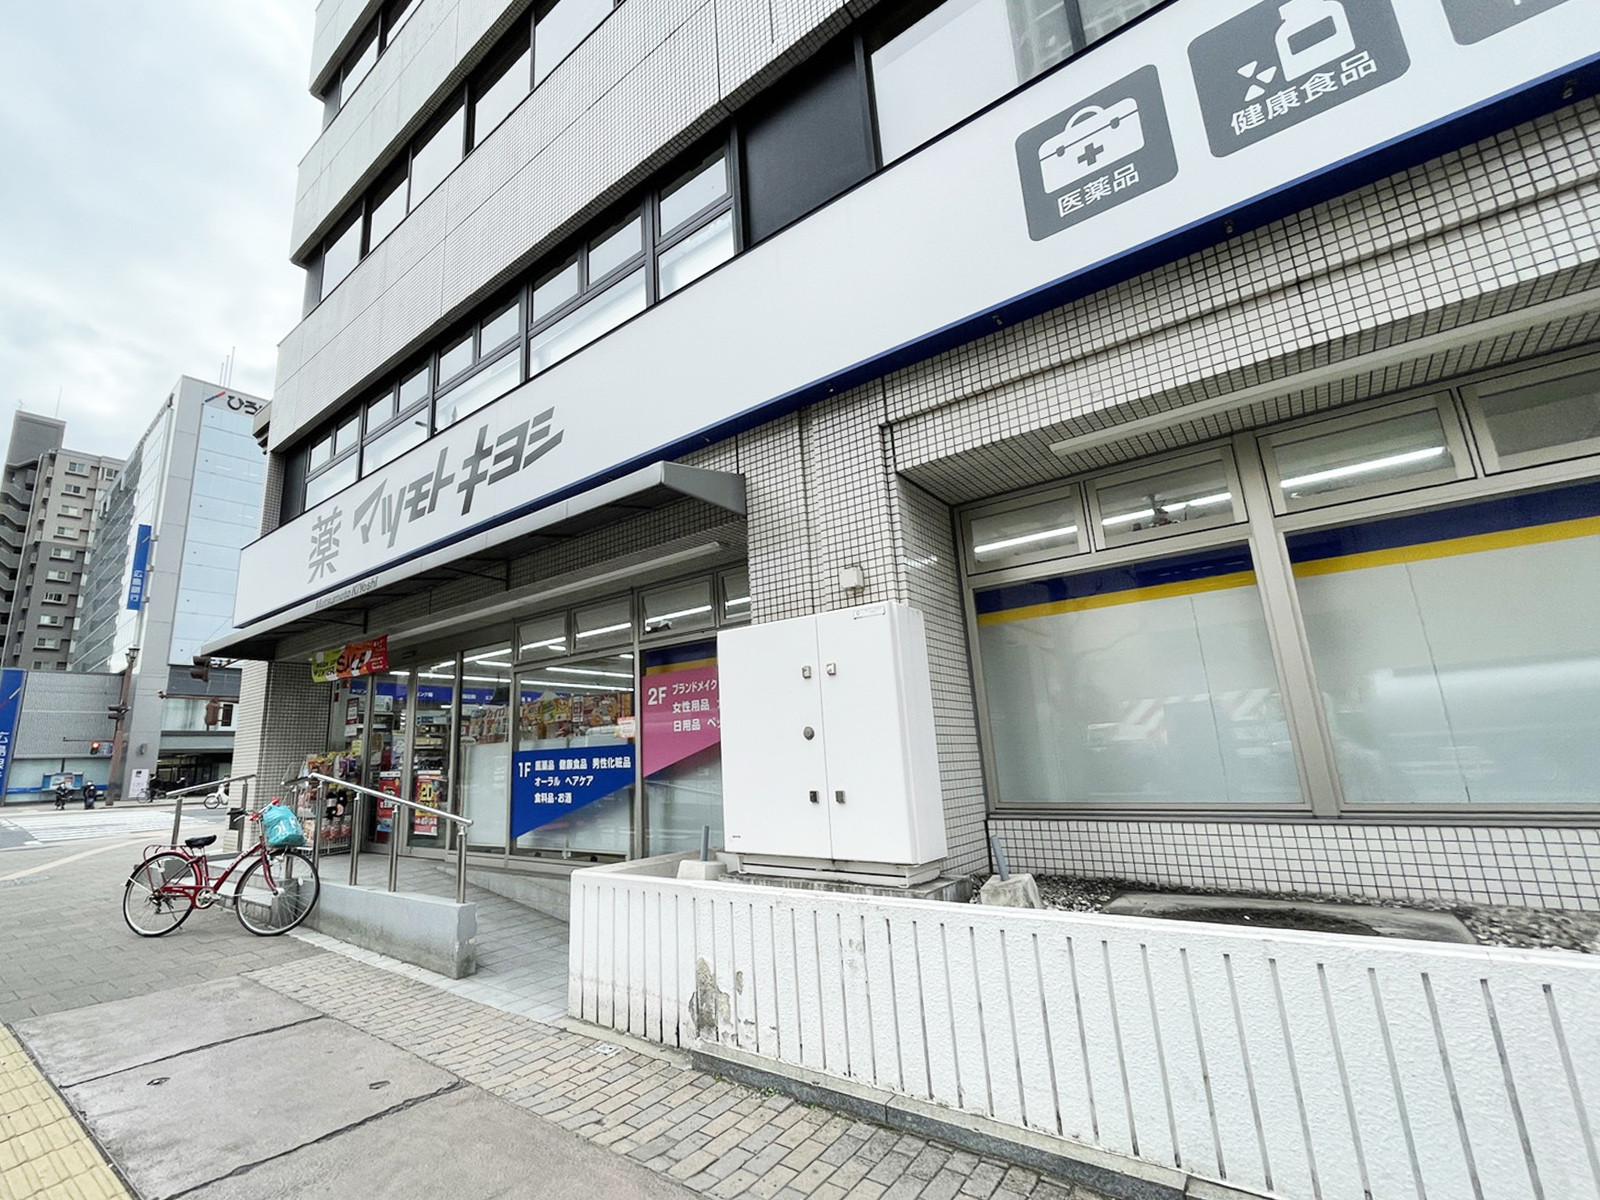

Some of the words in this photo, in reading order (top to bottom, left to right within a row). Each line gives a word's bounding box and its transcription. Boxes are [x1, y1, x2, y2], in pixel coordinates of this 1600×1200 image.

[1230, 50, 1378, 137] 健康食品
[1057, 162, 1141, 218] 医薬品
[227, 395, 262, 415] ひろ
[307, 505, 343, 584] 薬
[352, 406, 565, 549] マツモトキヨシ
[672, 679, 718, 695] ブランドメイク
[647, 686, 668, 706] 2F
[672, 698, 710, 714] 女性用品
[673, 718, 701, 732] 日用品
[518, 761, 532, 778] 1F
[591, 756, 632, 770] 男性化粧品
[534, 776, 561, 787] オーラル
[564, 775, 594, 787] ヘアケア
